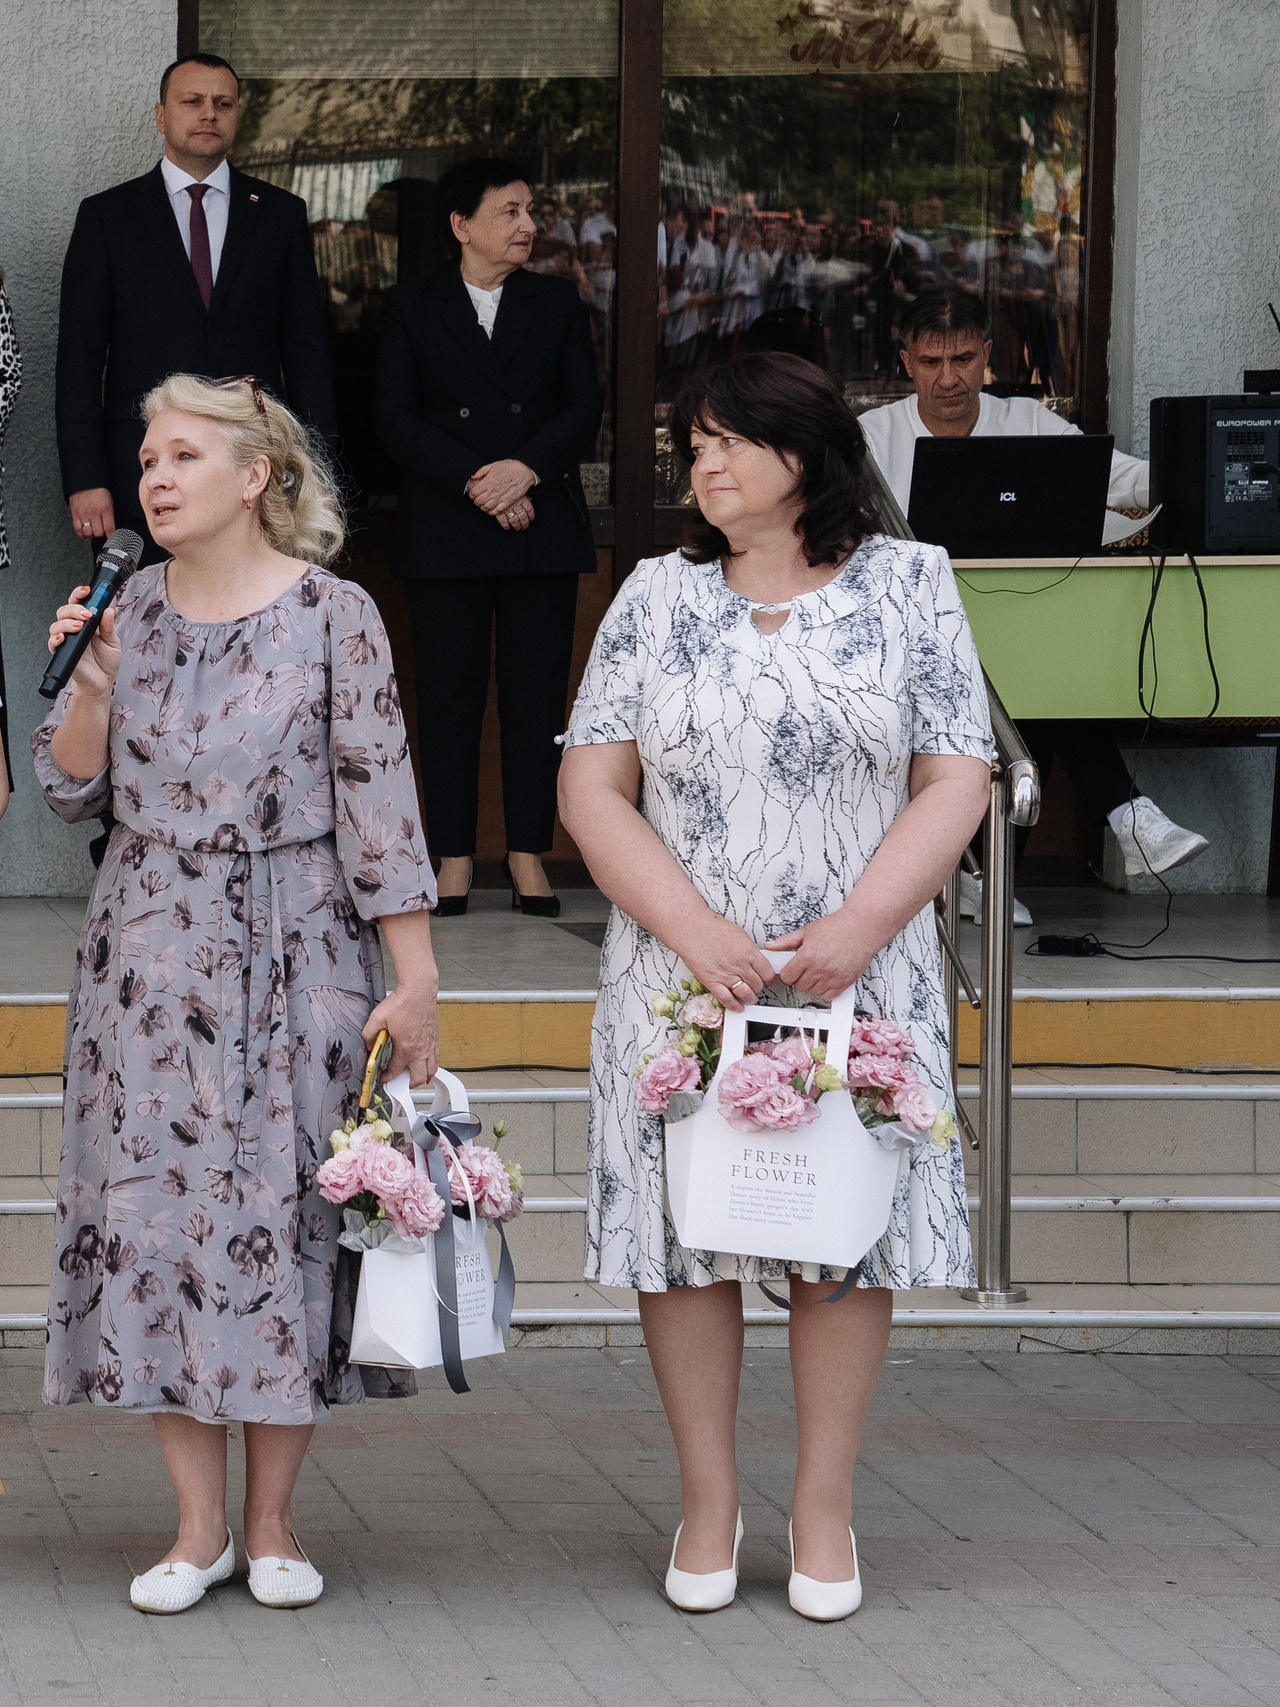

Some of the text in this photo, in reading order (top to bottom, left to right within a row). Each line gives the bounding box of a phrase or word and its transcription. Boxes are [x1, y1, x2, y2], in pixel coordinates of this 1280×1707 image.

[743, 1148, 808, 1168] FRESH
[730, 1164, 818, 1186] FLOWER
[456, 1252, 481, 1268] RESH
[457, 1269, 486, 1286] OWER
